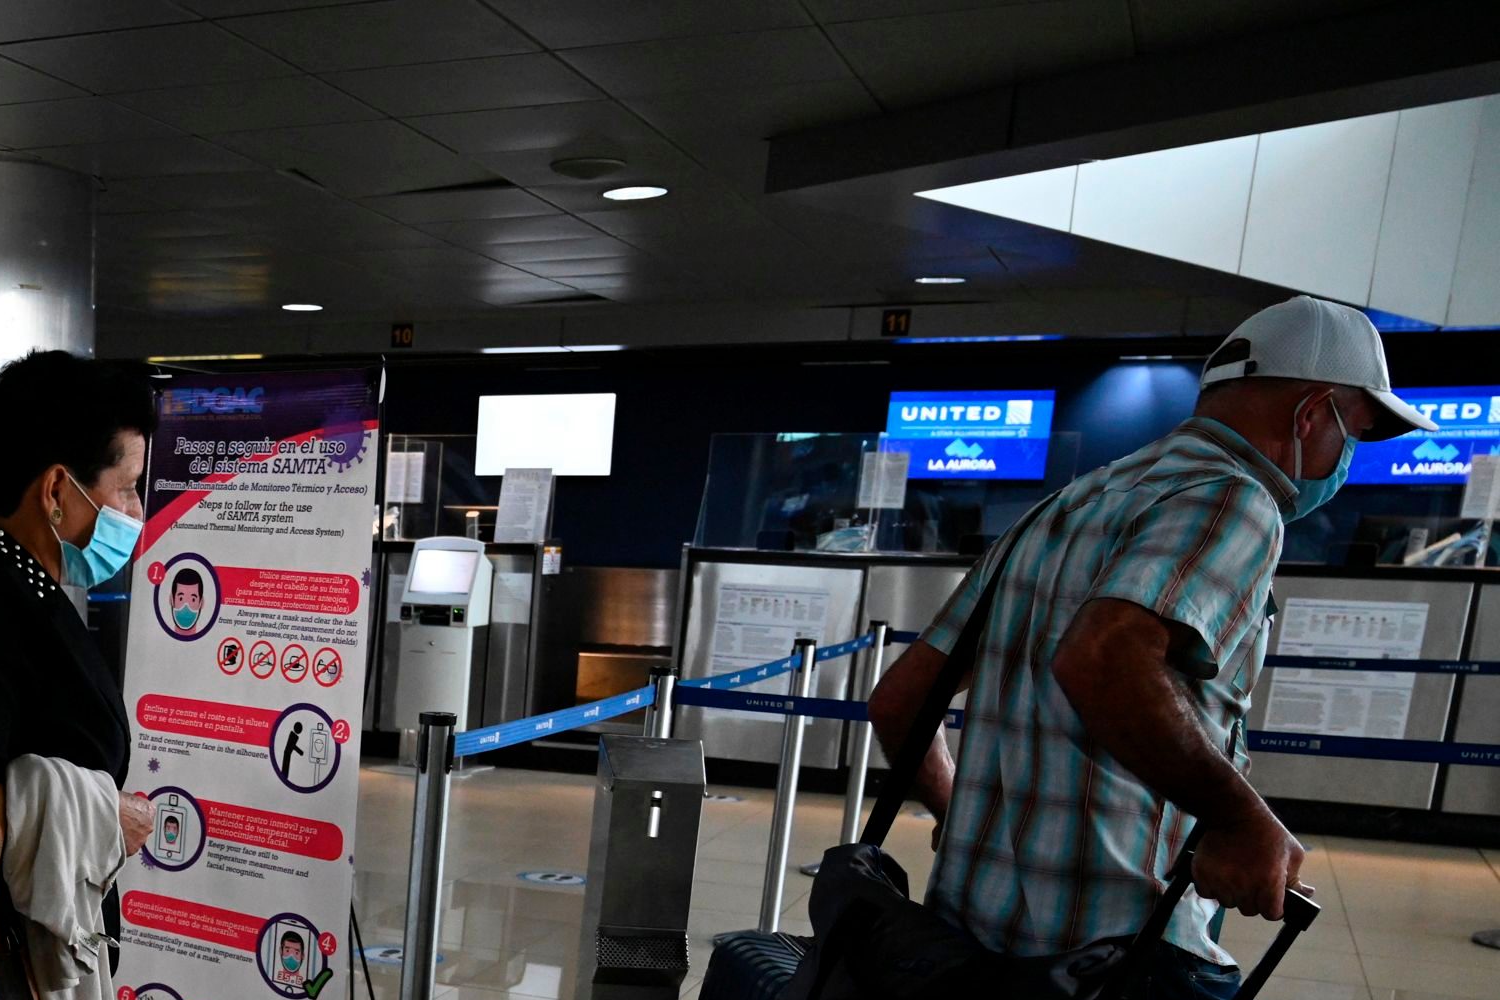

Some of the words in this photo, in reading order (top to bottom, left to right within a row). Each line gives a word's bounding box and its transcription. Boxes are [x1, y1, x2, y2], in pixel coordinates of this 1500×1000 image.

[886, 314, 908, 332] 11
[393, 328, 411, 343] 10
[901, 406, 1001, 421] UNITED
[175, 436, 214, 454] Pasos
[217, 442, 225, 451] a
[228, 437, 276, 457] seguir
[278, 442, 296, 454] en
[300, 437, 315, 452] el
[319, 441, 346, 454] uso
[189, 457, 212, 474] del
[215, 458, 268, 474] sistema
[272, 459, 327, 474] SAMTA
[927, 459, 944, 471] LA
[945, 459, 996, 471] AURORA
[1391, 463, 1412, 475] LA
[155, 480, 186, 490] (Sistema
[186, 481, 237, 492] Automatizado
[239, 482, 249, 492] de
[251, 482, 290, 493] Monitoreo
[327, 486, 332, 495] y
[334, 484, 368, 496] Acceso)
[198, 500, 222, 511] Steps
[225, 502, 233, 510] to
[234, 500, 262, 511] follow
[264, 501, 278, 512] for
[280, 502, 294, 512] the
[296, 504, 312, 512] use
[217, 512, 226, 521] of
[227, 512, 259, 522] SAMTA
[262, 513, 294, 524] system
[171, 522, 209, 530] (Automated
[210, 523, 236, 532] Thermal
[237, 525, 274, 534] Monitoring
[275, 526, 288, 534] and
[290, 527, 314, 535] Access
[315, 528, 344, 537] System)
[152, 566, 163, 580] 1.
[746, 698, 783, 708] UNITED
[334, 723, 348, 739] 2.
[138, 742, 150, 750] that
[168, 748, 191, 756] screen.
[1260, 738, 1307, 748] UNITED
[1461, 751, 1500, 761] UNITE
[208, 807, 245, 820] Mantener
[246, 815, 268, 825] rostro
[269, 819, 298, 831] inmóvil
[299, 825, 317, 835] para
[208, 817, 243, 830] medición
[246, 823, 255, 832] de
[256, 827, 303, 842] temperatura
[304, 835, 310, 844] y
[208, 827, 265, 844] reconocimiento
[208, 840, 225, 850] Keep
[226, 844, 241, 852] your
[242, 846, 257, 856] face
[258, 850, 270, 859] still
[207, 852, 247, 865] temperature
[249, 859, 294, 874] measurement
[296, 870, 309, 878] and
[207, 861, 224, 871] facial
[226, 865, 265, 879] recognition.
[322, 937, 335, 952] 4.
